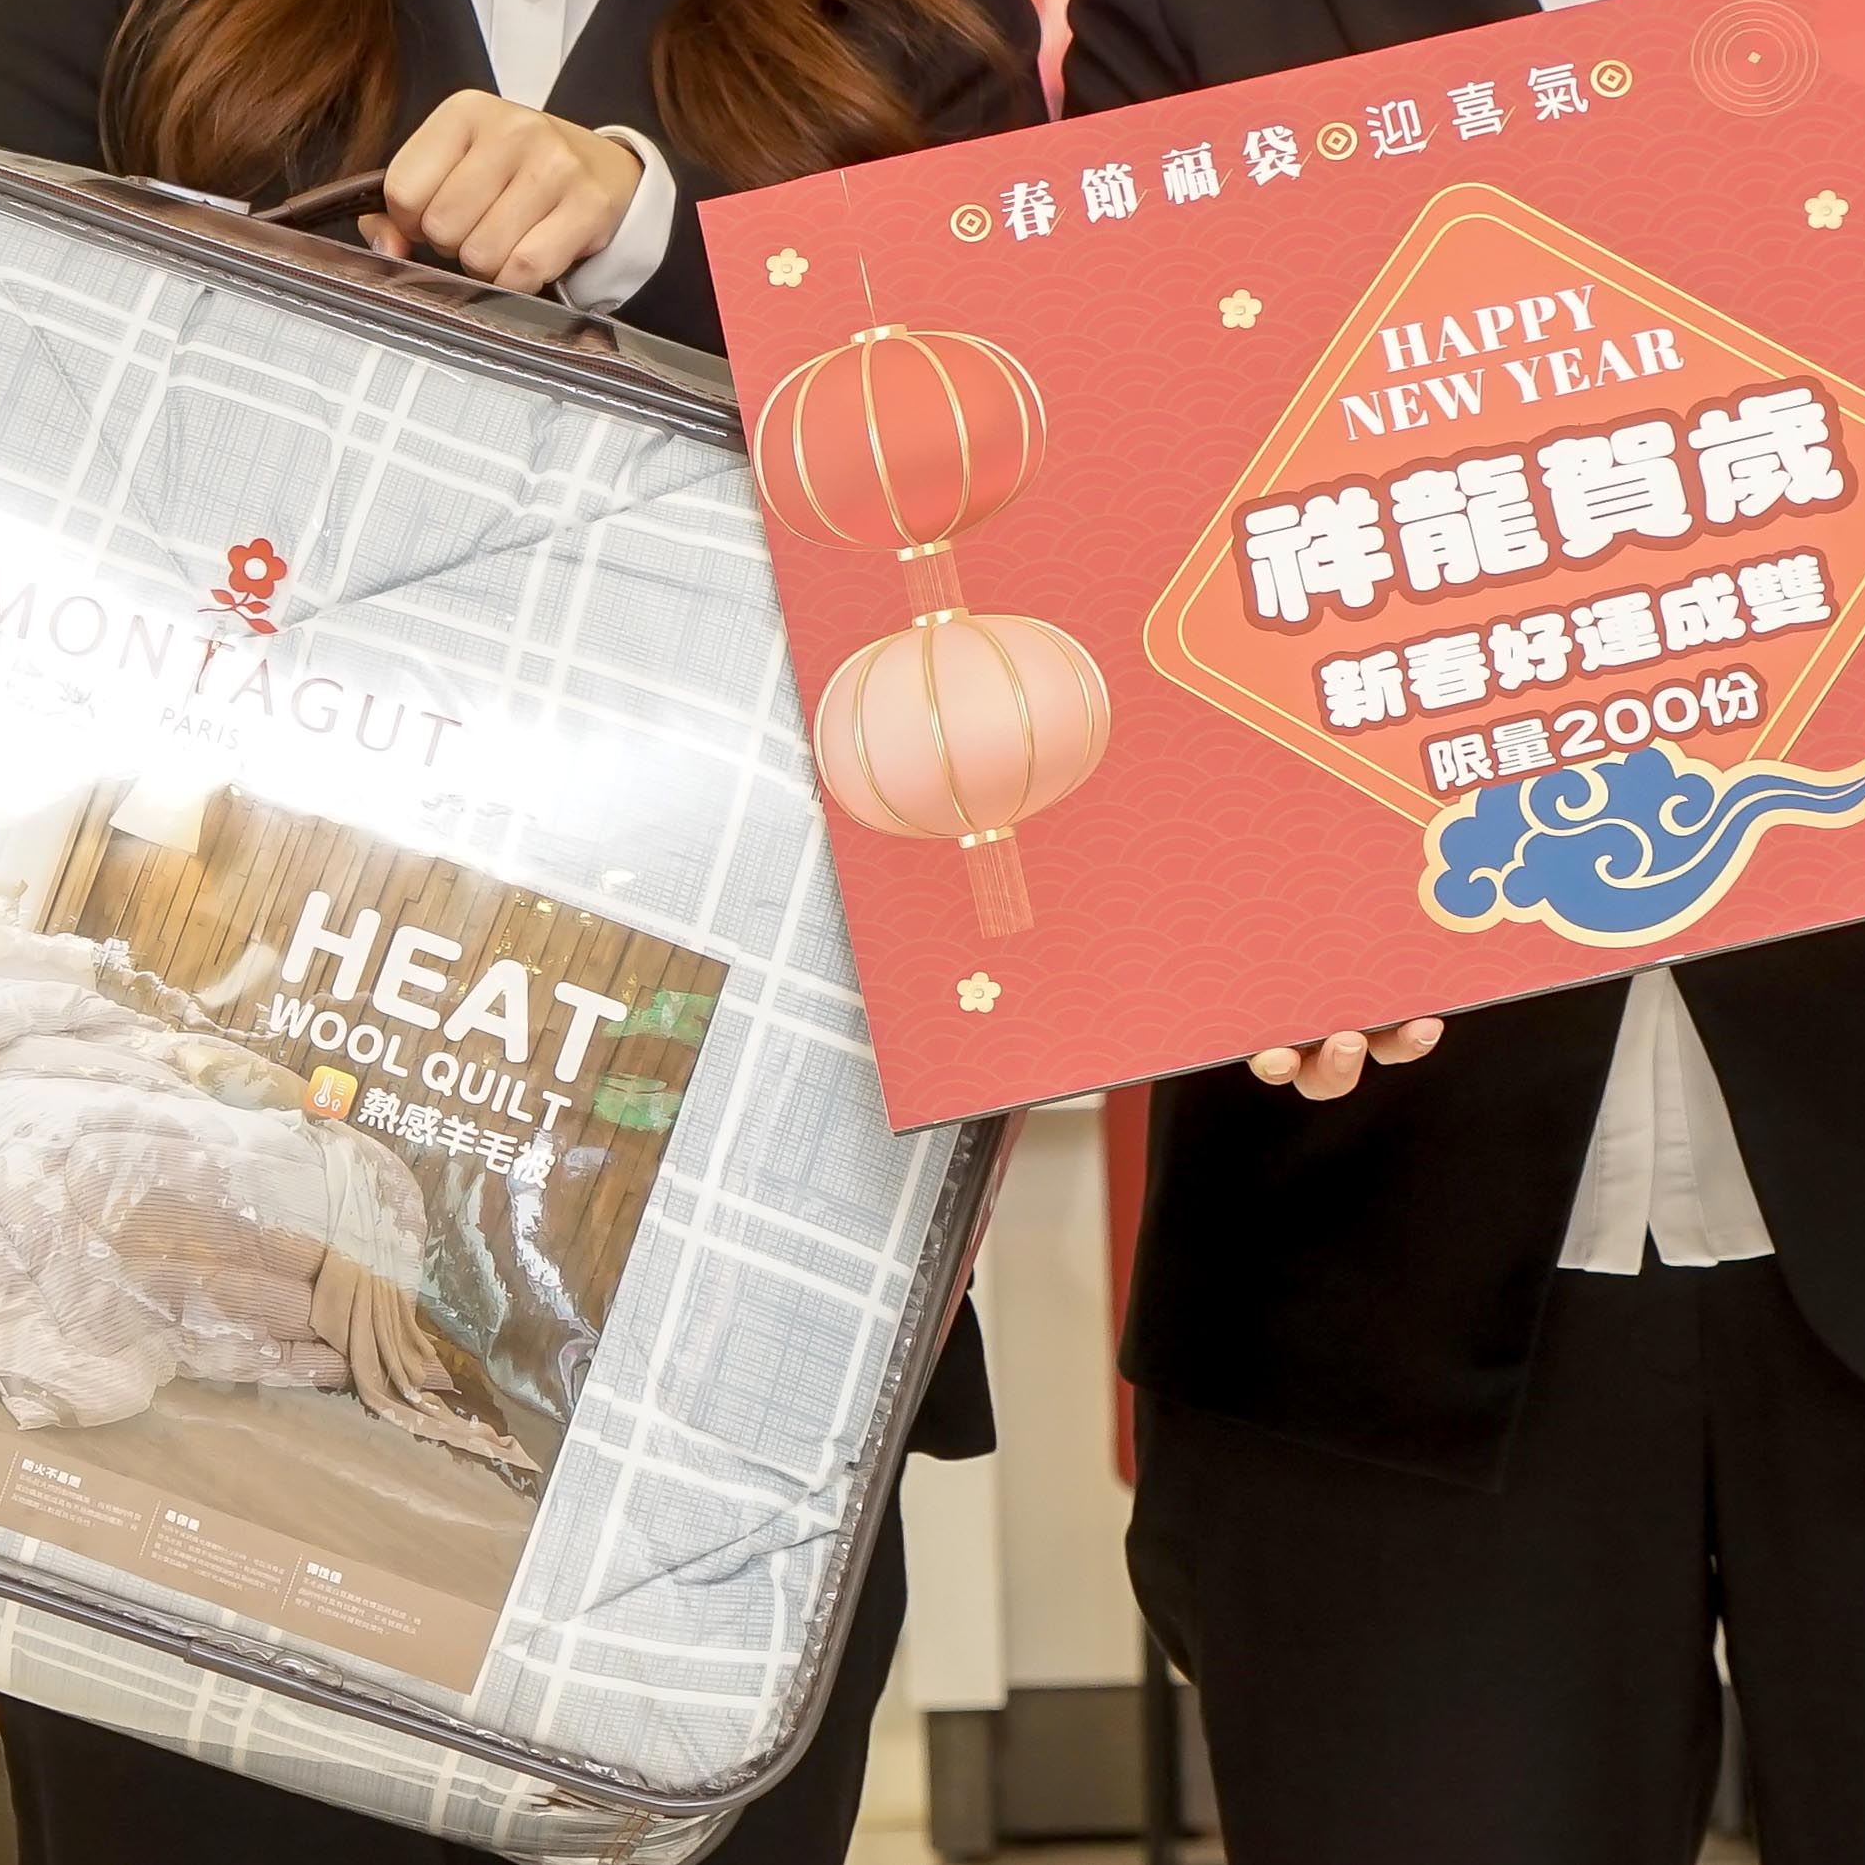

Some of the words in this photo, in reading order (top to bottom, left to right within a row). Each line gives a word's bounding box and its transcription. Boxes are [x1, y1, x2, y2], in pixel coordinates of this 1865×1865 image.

[1365, 62, 1589, 160] 迎喜氣
[999, 124, 1303, 241] 春節福袋
[1338, 369, 1487, 441] NEW
[1502, 326, 1685, 407] YEAR
[1378, 284, 1599, 373] HAPPY
[1243, 386, 1844, 625] 祥龍賀歲
[1320, 553, 1833, 729] 新春好運成雙
[159, 706, 240, 751] PARIS
[1428, 670, 1760, 792] 限量200份
[280, 889, 629, 1084] HEAT
[268, 992, 409, 1079] WOOL
[420, 1054, 573, 1132] QUILT
[356, 1085, 557, 1190] 熱感羊毛被
